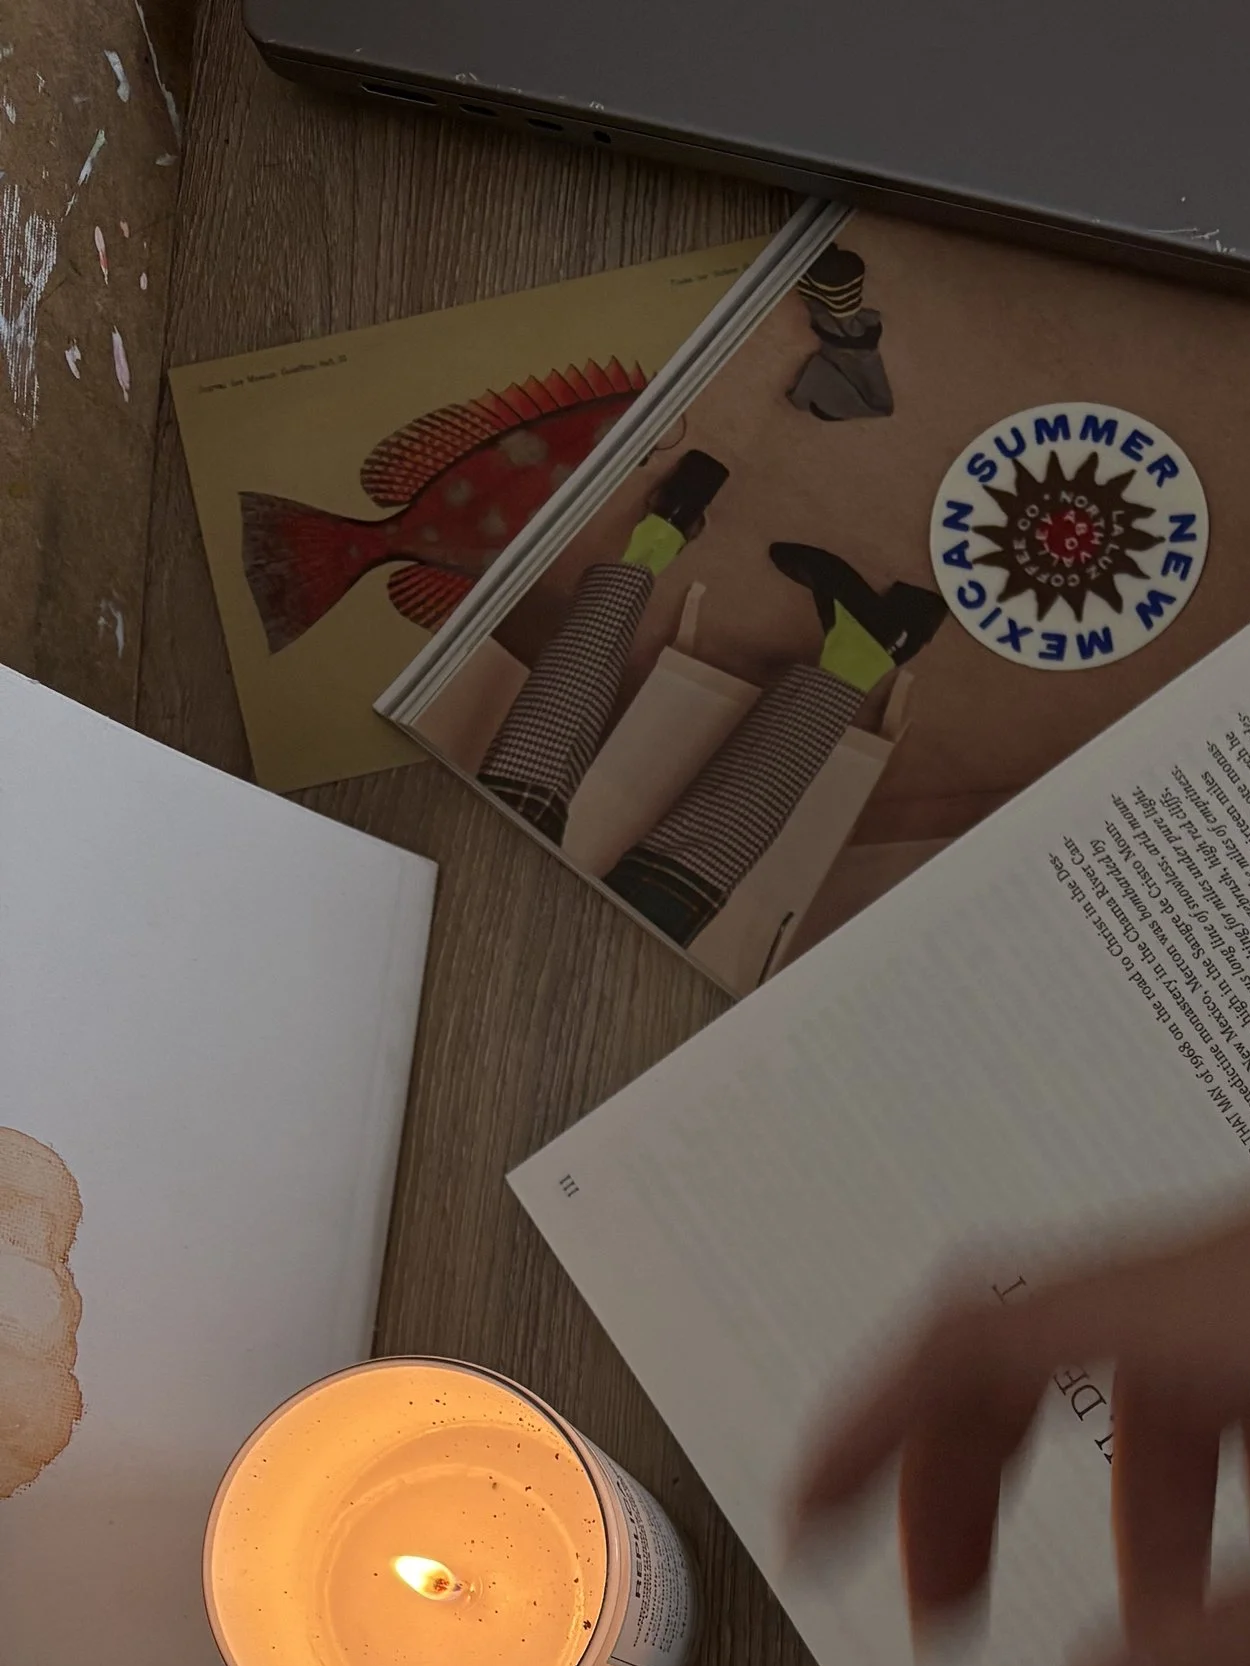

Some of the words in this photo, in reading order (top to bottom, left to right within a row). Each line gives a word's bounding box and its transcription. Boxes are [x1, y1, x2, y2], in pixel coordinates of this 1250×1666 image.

[967, 414, 1180, 487] SUMMER
[943, 499, 1113, 661] MEXICAN
[1134, 512, 1197, 630] NEW
[1048, 852, 1071, 882] Des-
[1067, 879, 1086, 903] the
[1082, 901, 1097, 919] in
[1092, 915, 1123, 957] Christ
[1121, 955, 1135, 972] to
[1128, 970, 1156, 1000] road
[1152, 1000, 1171, 1023] the
[1168, 1022, 1184, 1041] on
[1177, 1041, 1204, 1069] 1968
[1195, 1068, 1214, 1084] of
[1206, 1085, 1233, 1113] MAY
